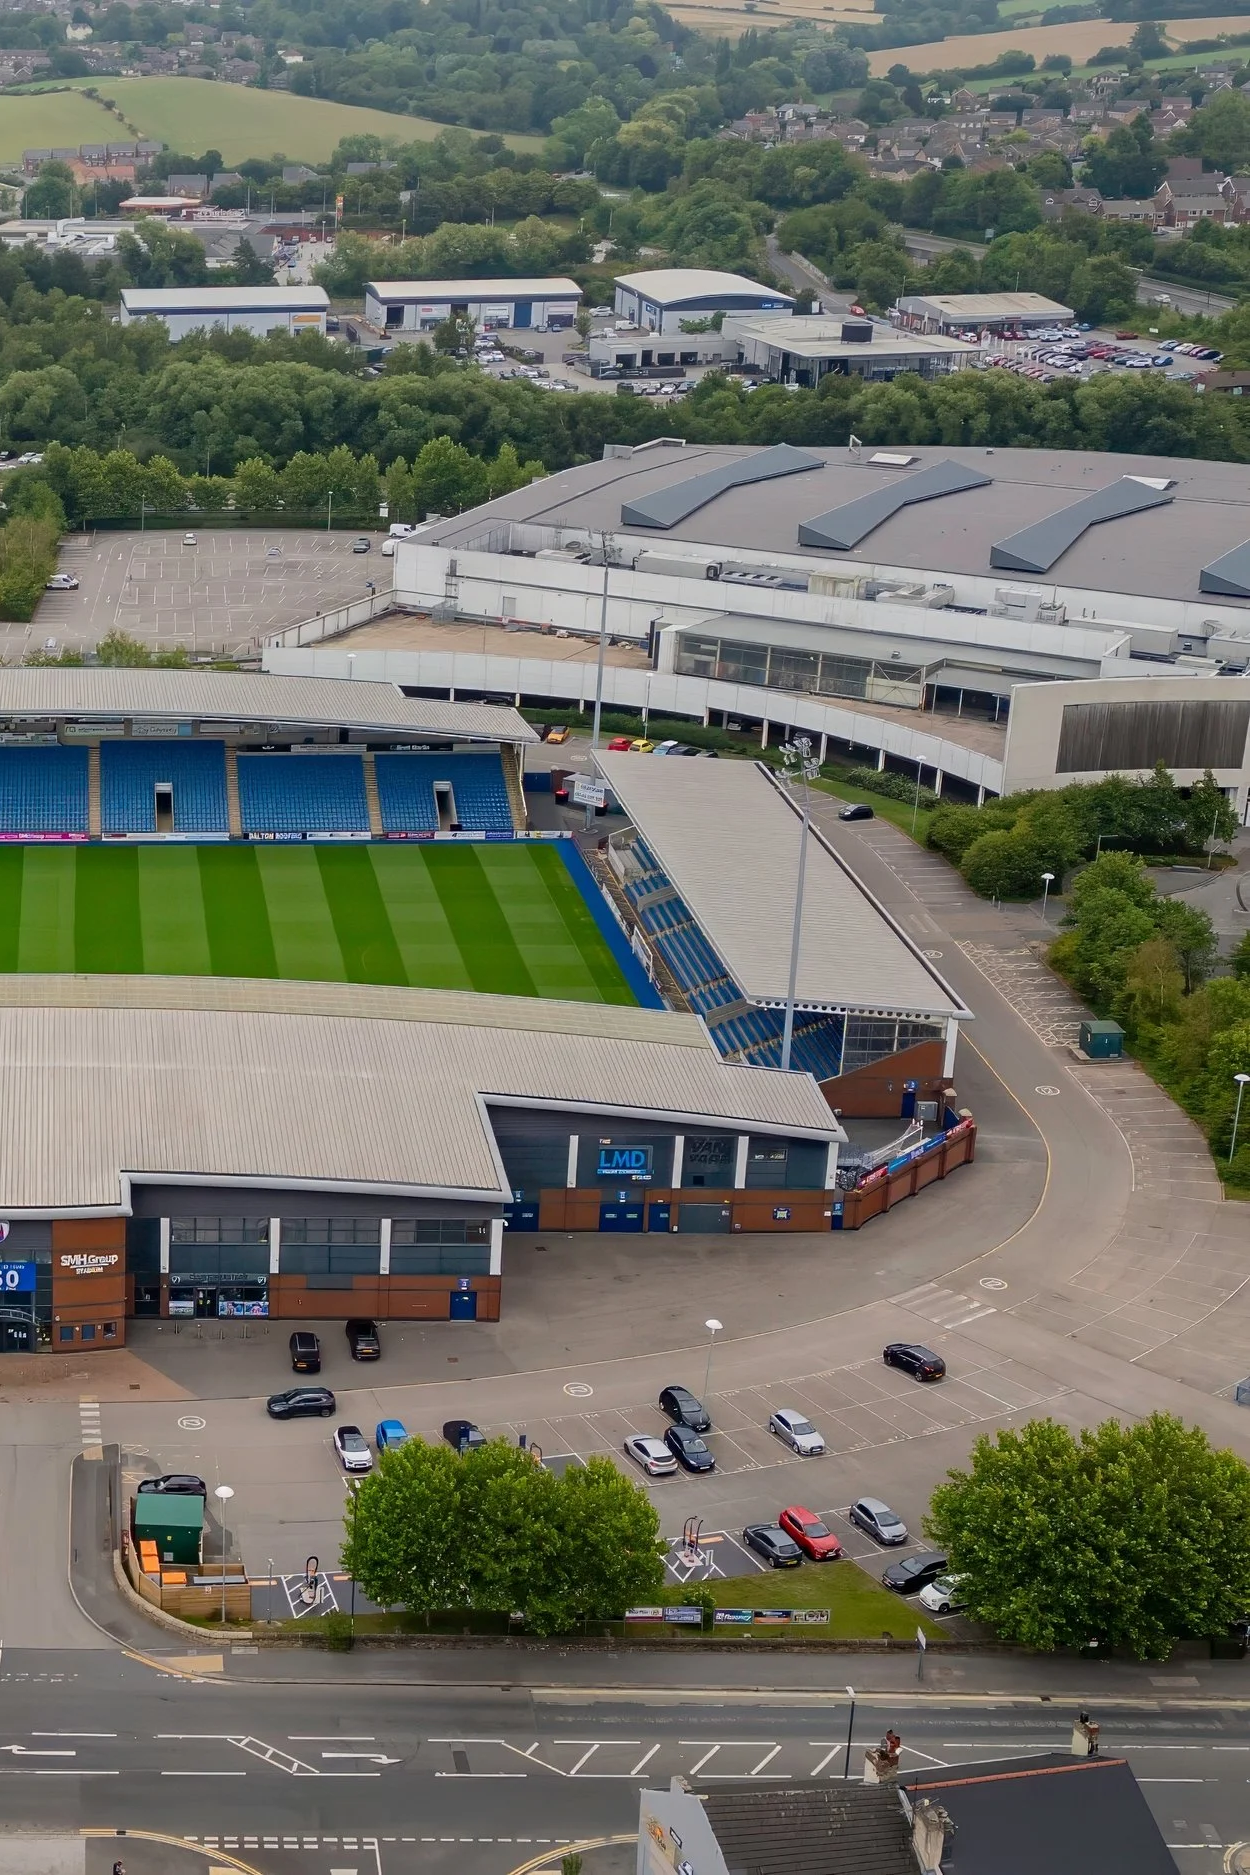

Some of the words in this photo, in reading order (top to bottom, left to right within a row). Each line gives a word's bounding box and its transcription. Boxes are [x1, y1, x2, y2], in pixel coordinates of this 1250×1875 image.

[599, 1150, 646, 1168] LMD
[60, 1253, 87, 1267] SMH
[88, 1254, 119, 1266] Group
